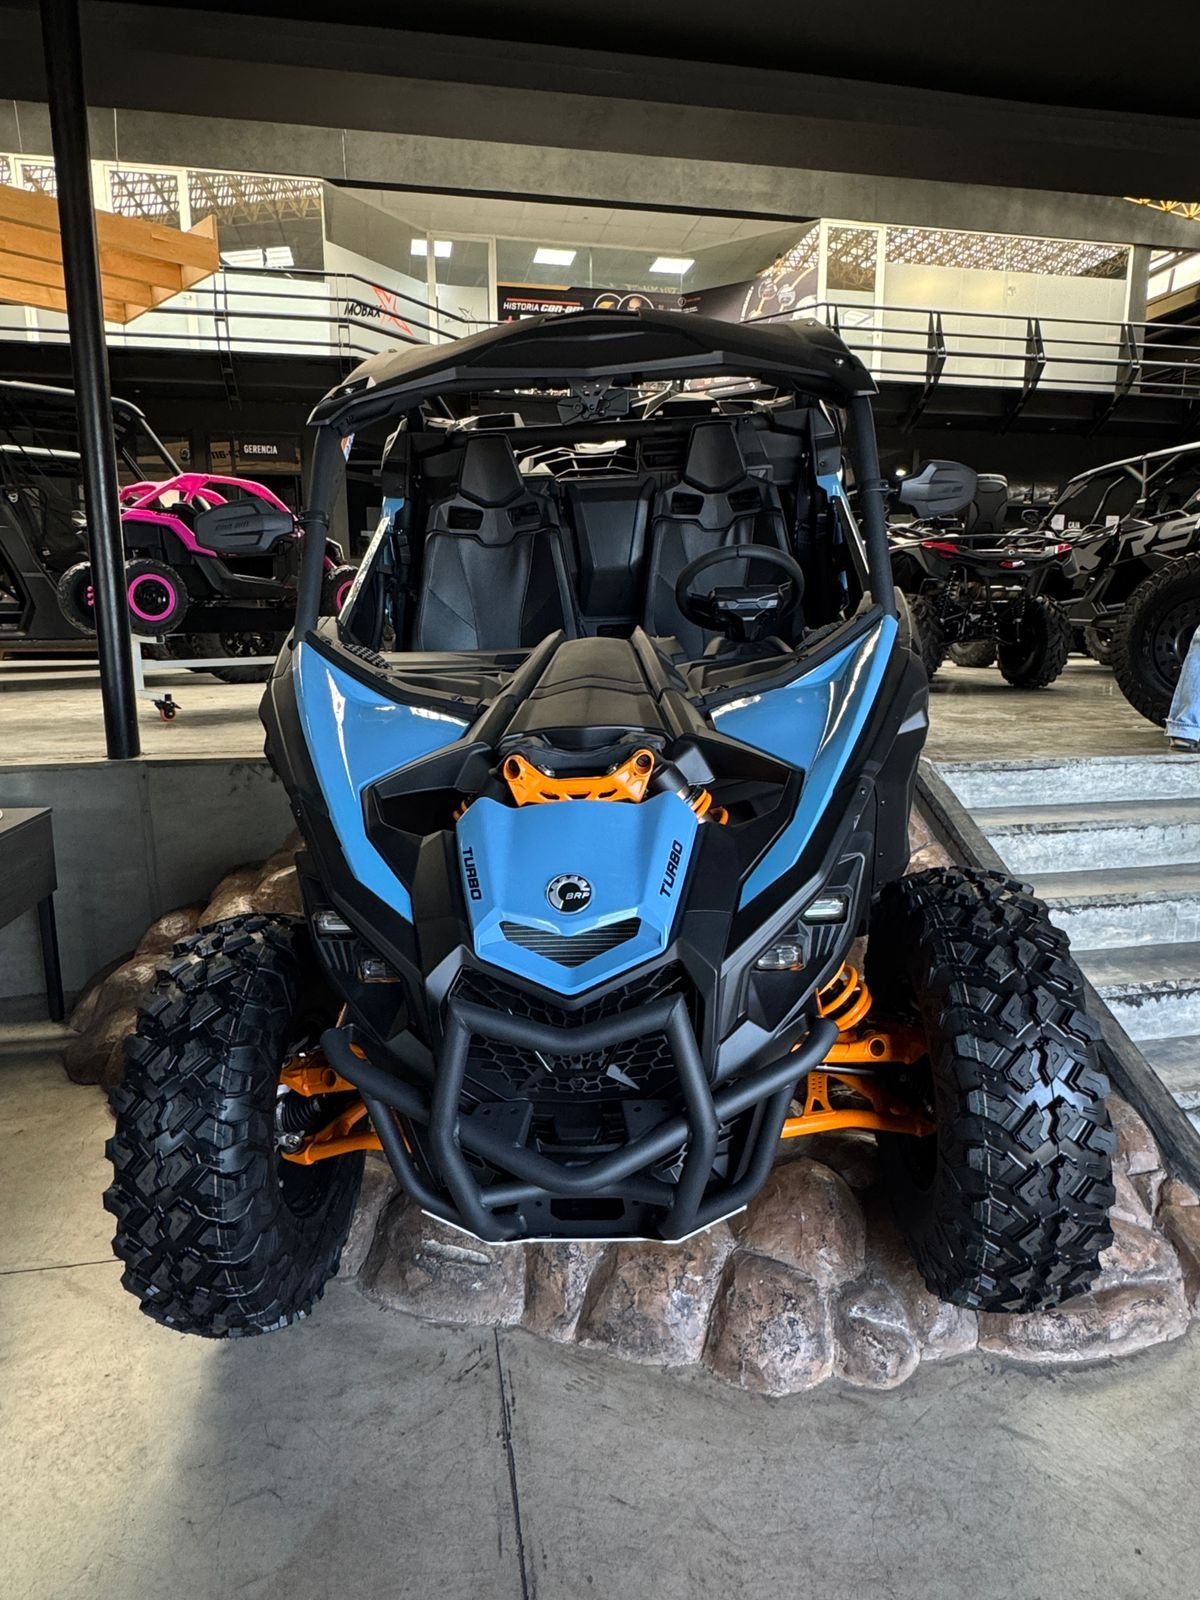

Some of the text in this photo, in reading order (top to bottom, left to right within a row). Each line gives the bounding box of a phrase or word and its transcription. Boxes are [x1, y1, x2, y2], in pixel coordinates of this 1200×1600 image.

[503, 302, 540, 312] HISTORIA
[243, 444, 278, 455] GERENCIA
[462, 846, 482, 901] TURBO
[660, 839, 683, 898] TURBO
[565, 891, 590, 900] BRP
